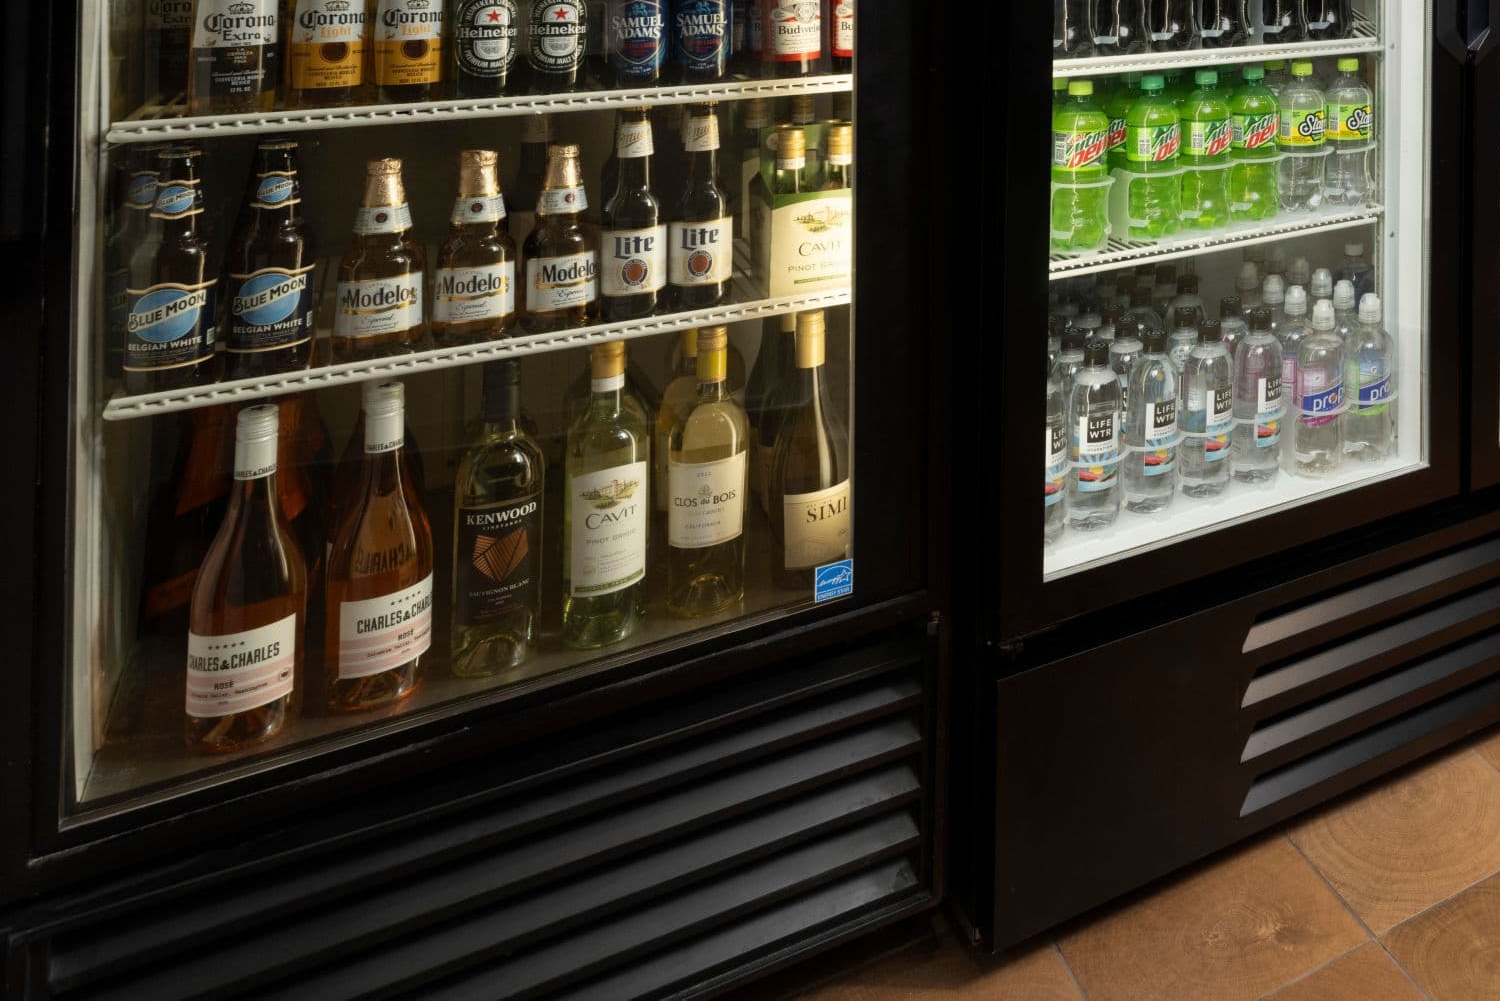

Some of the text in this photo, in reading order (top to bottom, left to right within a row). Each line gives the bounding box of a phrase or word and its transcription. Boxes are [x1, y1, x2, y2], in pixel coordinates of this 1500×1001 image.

[204, 12, 276, 31] Corona
[300, 11, 366, 32] Corona
[612, 13, 665, 29] SAMUEL
[676, 12, 727, 26] SAMUEL
[222, 30, 261, 42] Extra
[460, 26, 518, 38] Heineken
[529, 23, 586, 35] Heineken
[615, 24, 662, 39] ADAMS
[680, 24, 725, 37] ADAMS
[614, 235, 655, 260] Lite
[680, 226, 719, 251] Lite
[542, 259, 596, 283] Modelo
[442, 272, 502, 295] Modelo
[233, 275, 306, 316] BLUE MOON
[346, 286, 411, 309] Modelo
[128, 289, 206, 332] BLUE MOON
[233, 318, 303, 334] BELGIAN WHITE
[128, 335, 202, 352] BELGIAN WHITE
[1156, 404, 1175, 414] LIFE
[1090, 419, 1112, 429] LIFE
[1156, 413, 1175, 424] WTR
[1090, 429, 1112, 439] WTR
[674, 496, 699, 508] CLOS
[713, 489, 737, 504] BOIS
[467, 501, 537, 526] KENWOOD
[585, 504, 638, 531] CAVIT
[806, 495, 848, 523] SIMI
